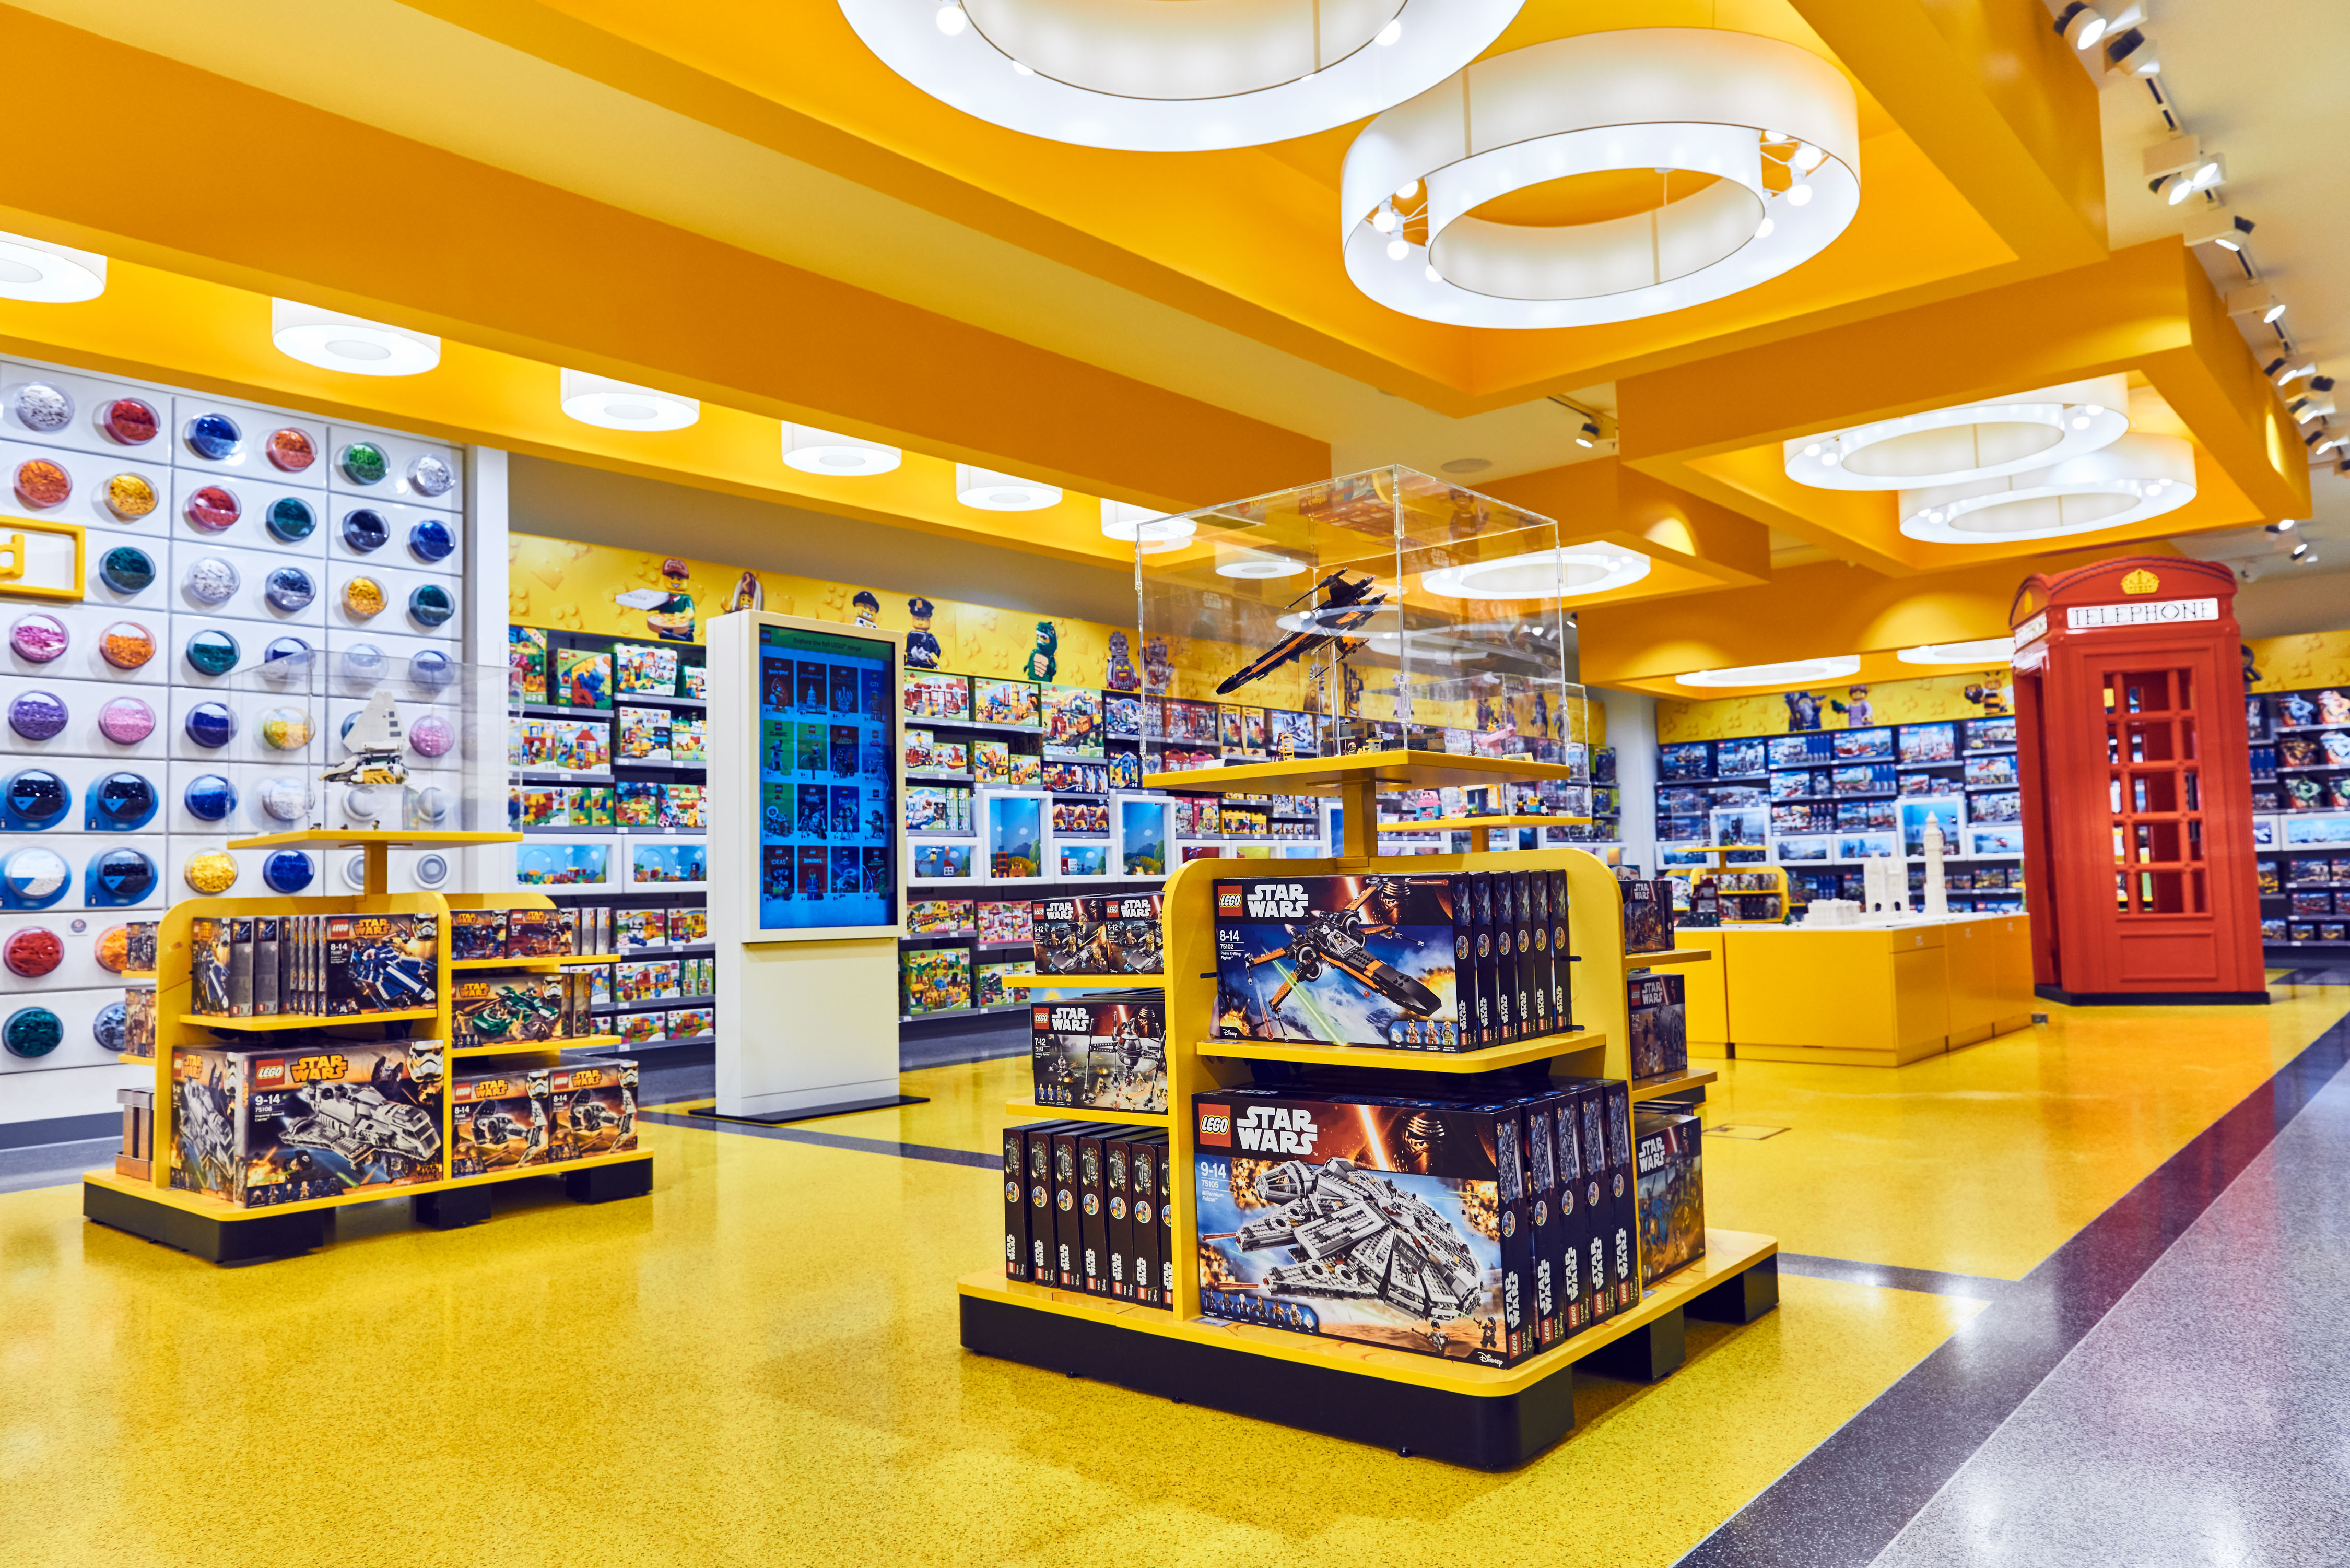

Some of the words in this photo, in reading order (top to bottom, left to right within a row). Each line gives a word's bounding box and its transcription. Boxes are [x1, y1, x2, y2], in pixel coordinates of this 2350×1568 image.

[2073, 600, 2213, 626] TELEPHONE
[1247, 884, 1308, 901] STAR
[1634, 891, 1649, 900] WARS
[1121, 899, 1151, 909] STAR
[1220, 894, 1241, 907] LEGO
[1046, 902, 1073, 911] STAR
[1247, 901, 1308, 917] WARS
[1046, 911, 1073, 920] WARS
[1121, 908, 1151, 918] WARS
[332, 923, 348, 932] LEGO
[354, 918, 391, 928] STAR
[354, 925, 391, 935] WARS
[1219, 930, 1239, 941] 8-14
[331, 942, 347, 951] 8-14
[460, 988, 490, 997] WARS
[1642, 982, 1662, 994] STAR
[1642, 992, 1663, 1005] WARS
[1035, 1014, 1048, 1022] LEGO
[1052, 1008, 1089, 1019] STAR
[1052, 1019, 1089, 1031] WARS
[1035, 1038, 1046, 1046] 7-12
[291, 1054, 347, 1070] STAR
[258, 1066, 283, 1079] LEGO
[291, 1065, 347, 1083] WARS
[572, 1069, 602, 1080] STAR
[475, 1080, 508, 1091] STAR
[554, 1077, 568, 1085] LEGO
[572, 1075, 602, 1087] WARS
[456, 1087, 471, 1096] LEGO
[475, 1086, 508, 1098] WARS
[255, 1094, 280, 1106] 9-14
[554, 1094, 567, 1103] 8-14
[454, 1106, 469, 1114] 8-14
[1201, 1116, 1229, 1134] LEGO
[1237, 1106, 1318, 1133] STAR
[1237, 1127, 1318, 1155] WARS
[1639, 1137, 1665, 1158] STAR
[1639, 1152, 1665, 1173] WARS
[1201, 1162, 1226, 1178] 9-14
[1201, 1179, 1219, 1188] 75105
[1543, 1259, 1552, 1315] WARS
[1511, 1271, 1520, 1329] WARS
